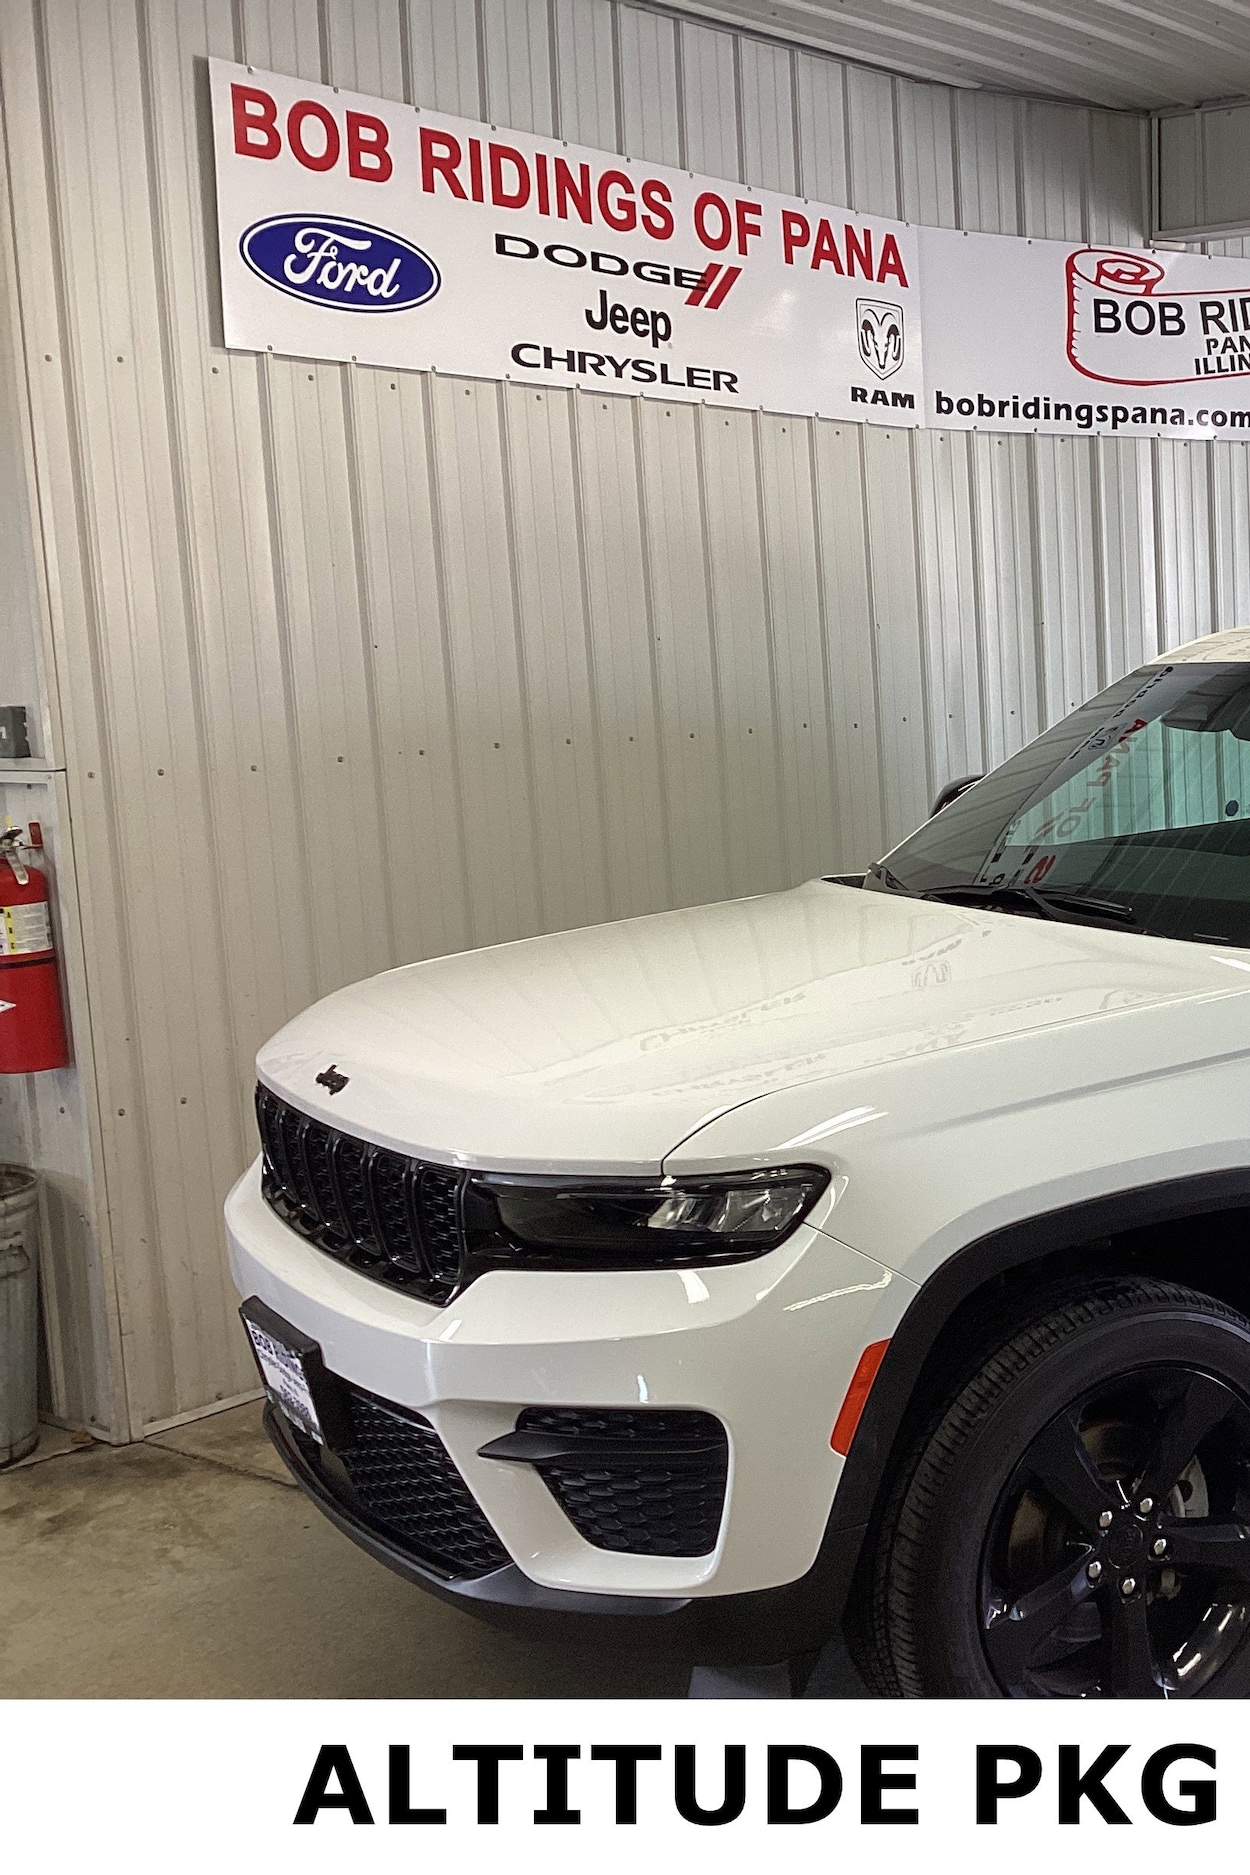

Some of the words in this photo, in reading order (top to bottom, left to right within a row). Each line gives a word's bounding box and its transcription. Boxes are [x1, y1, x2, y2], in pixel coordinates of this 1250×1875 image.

[231, 83, 393, 183] BOB
[420, 127, 675, 241] RIDINGS
[693, 191, 762, 256] OF
[781, 209, 909, 288] PANA
[283, 227, 401, 299] Ford
[494, 233, 708, 291] DODGE
[584, 289, 672, 348] Jeep
[1093, 298, 1186, 336] BOB
[511, 343, 740, 394] CHRYSLER
[851, 386, 915, 410] RAM
